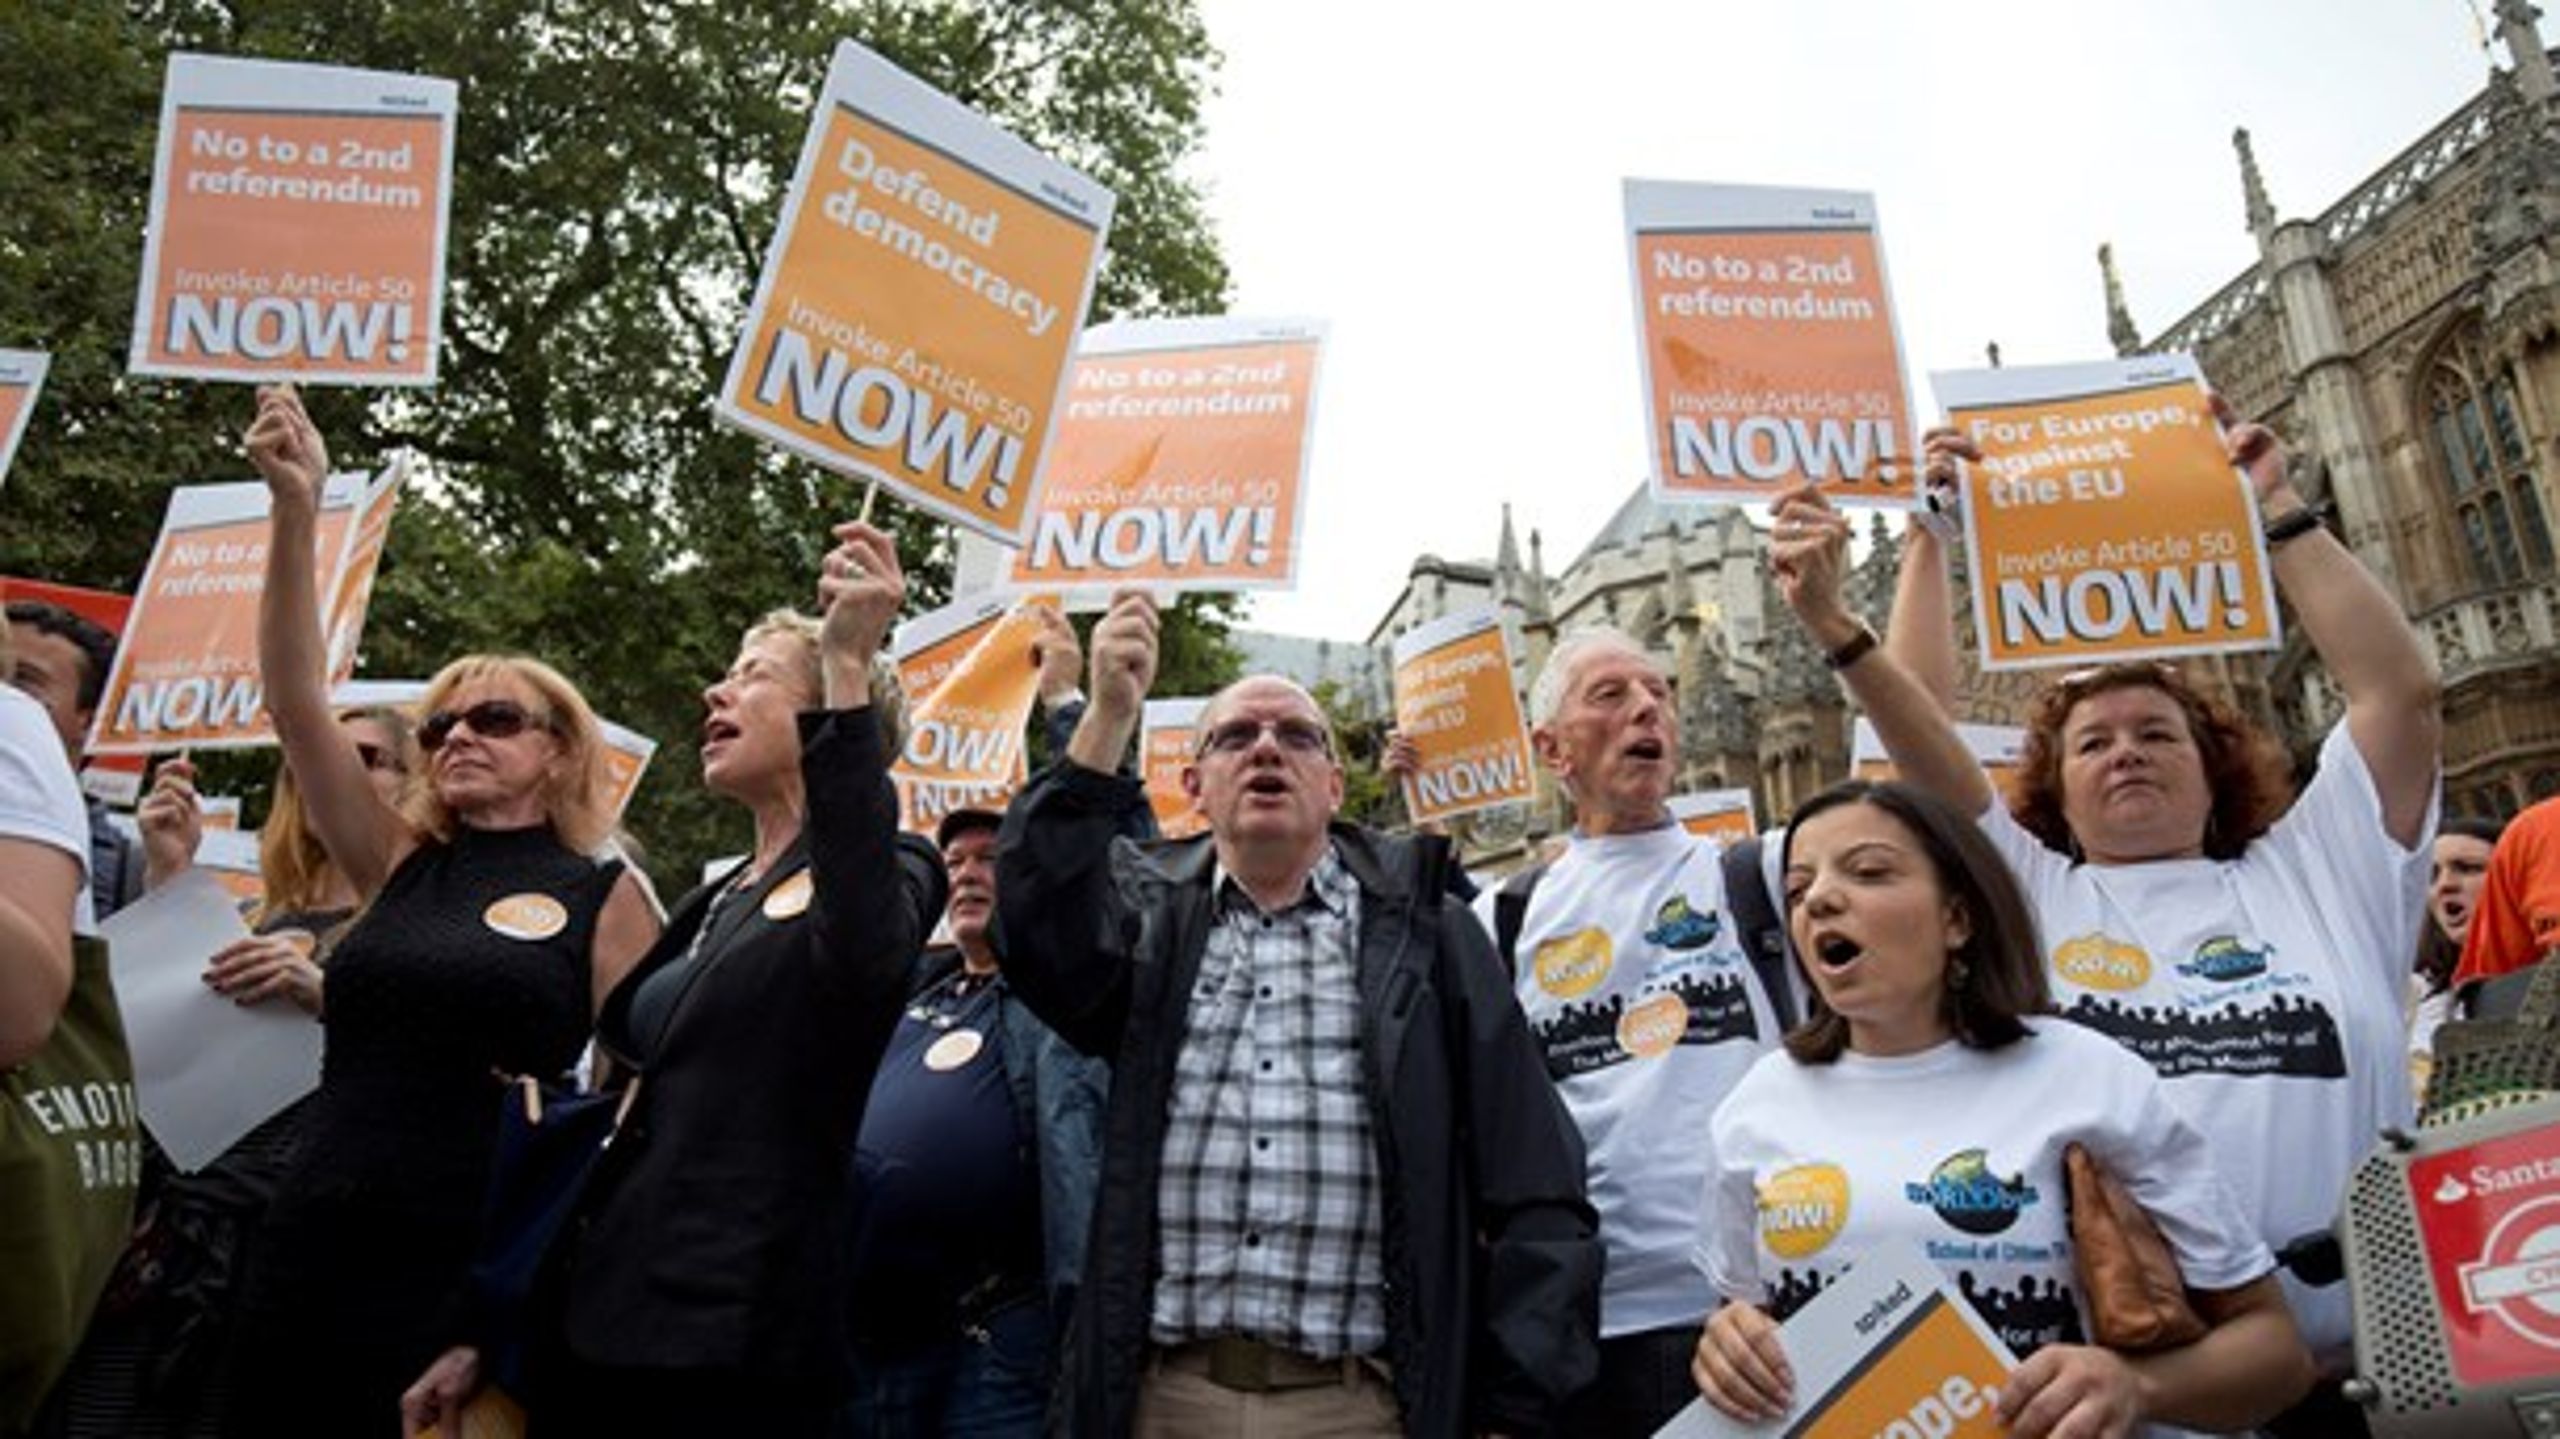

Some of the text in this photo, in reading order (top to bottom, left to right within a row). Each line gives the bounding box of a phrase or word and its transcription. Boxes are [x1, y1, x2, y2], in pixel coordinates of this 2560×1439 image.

[192, 130, 412, 172] No to a 2nd
[187, 167, 421, 208] referendum
[838, 137, 1000, 247] Defend
[176, 268, 415, 299] Invoke Article 50
[821, 188, 1058, 337] democracy
[1654, 251, 1855, 284] No to a 2nd
[167, 294, 411, 363] NOW!
[1659, 287, 1873, 320] referendum
[788, 297, 1033, 434] Invoke Article 50
[1076, 360, 1287, 389] No to a 2nd
[756, 326, 1025, 510] NOW!
[1067, 390, 1292, 419] referendum
[1970, 402, 2200, 443] For Europe,
[1671, 415, 1899, 486] NOW!
[1141, 479, 1236, 504] Article
[1989, 468, 2125, 507] the EU
[170, 543, 208, 567] No
[1028, 505, 1277, 571] NOW!
[1996, 531, 2238, 574] Invoke Article 50
[1999, 560, 2249, 647] NOW!
[114, 676, 266, 735] NOW
[904, 719, 1014, 774] OW!
[1417, 752, 1526, 809] NOW!
[1854, 1279, 1914, 1335] spiked
[1873, 1375, 2000, 1439] ope,
